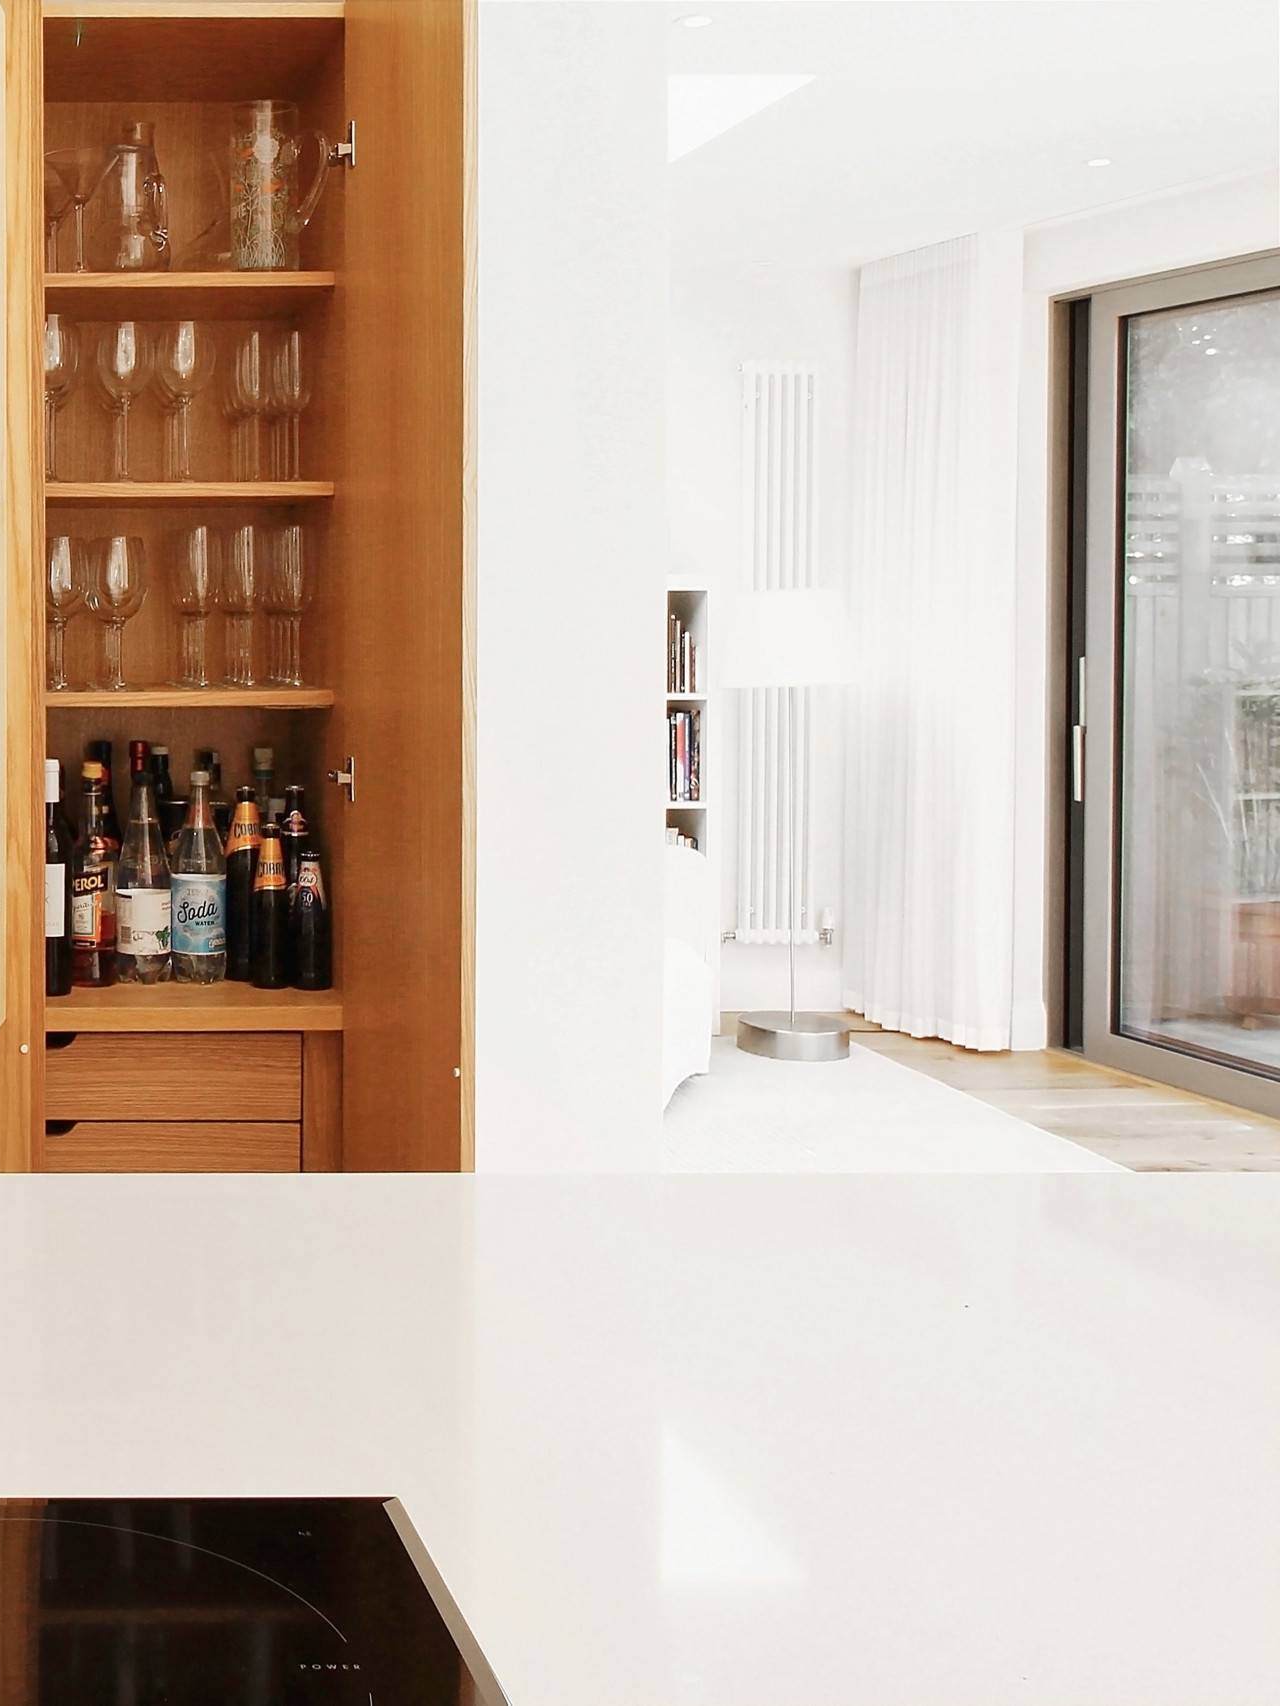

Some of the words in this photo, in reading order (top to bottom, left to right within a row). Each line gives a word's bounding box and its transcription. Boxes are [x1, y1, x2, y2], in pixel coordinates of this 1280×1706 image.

[233, 822, 261, 838] COBR
[73, 875, 105, 892] EROL
[176, 900, 218, 924] Soda
